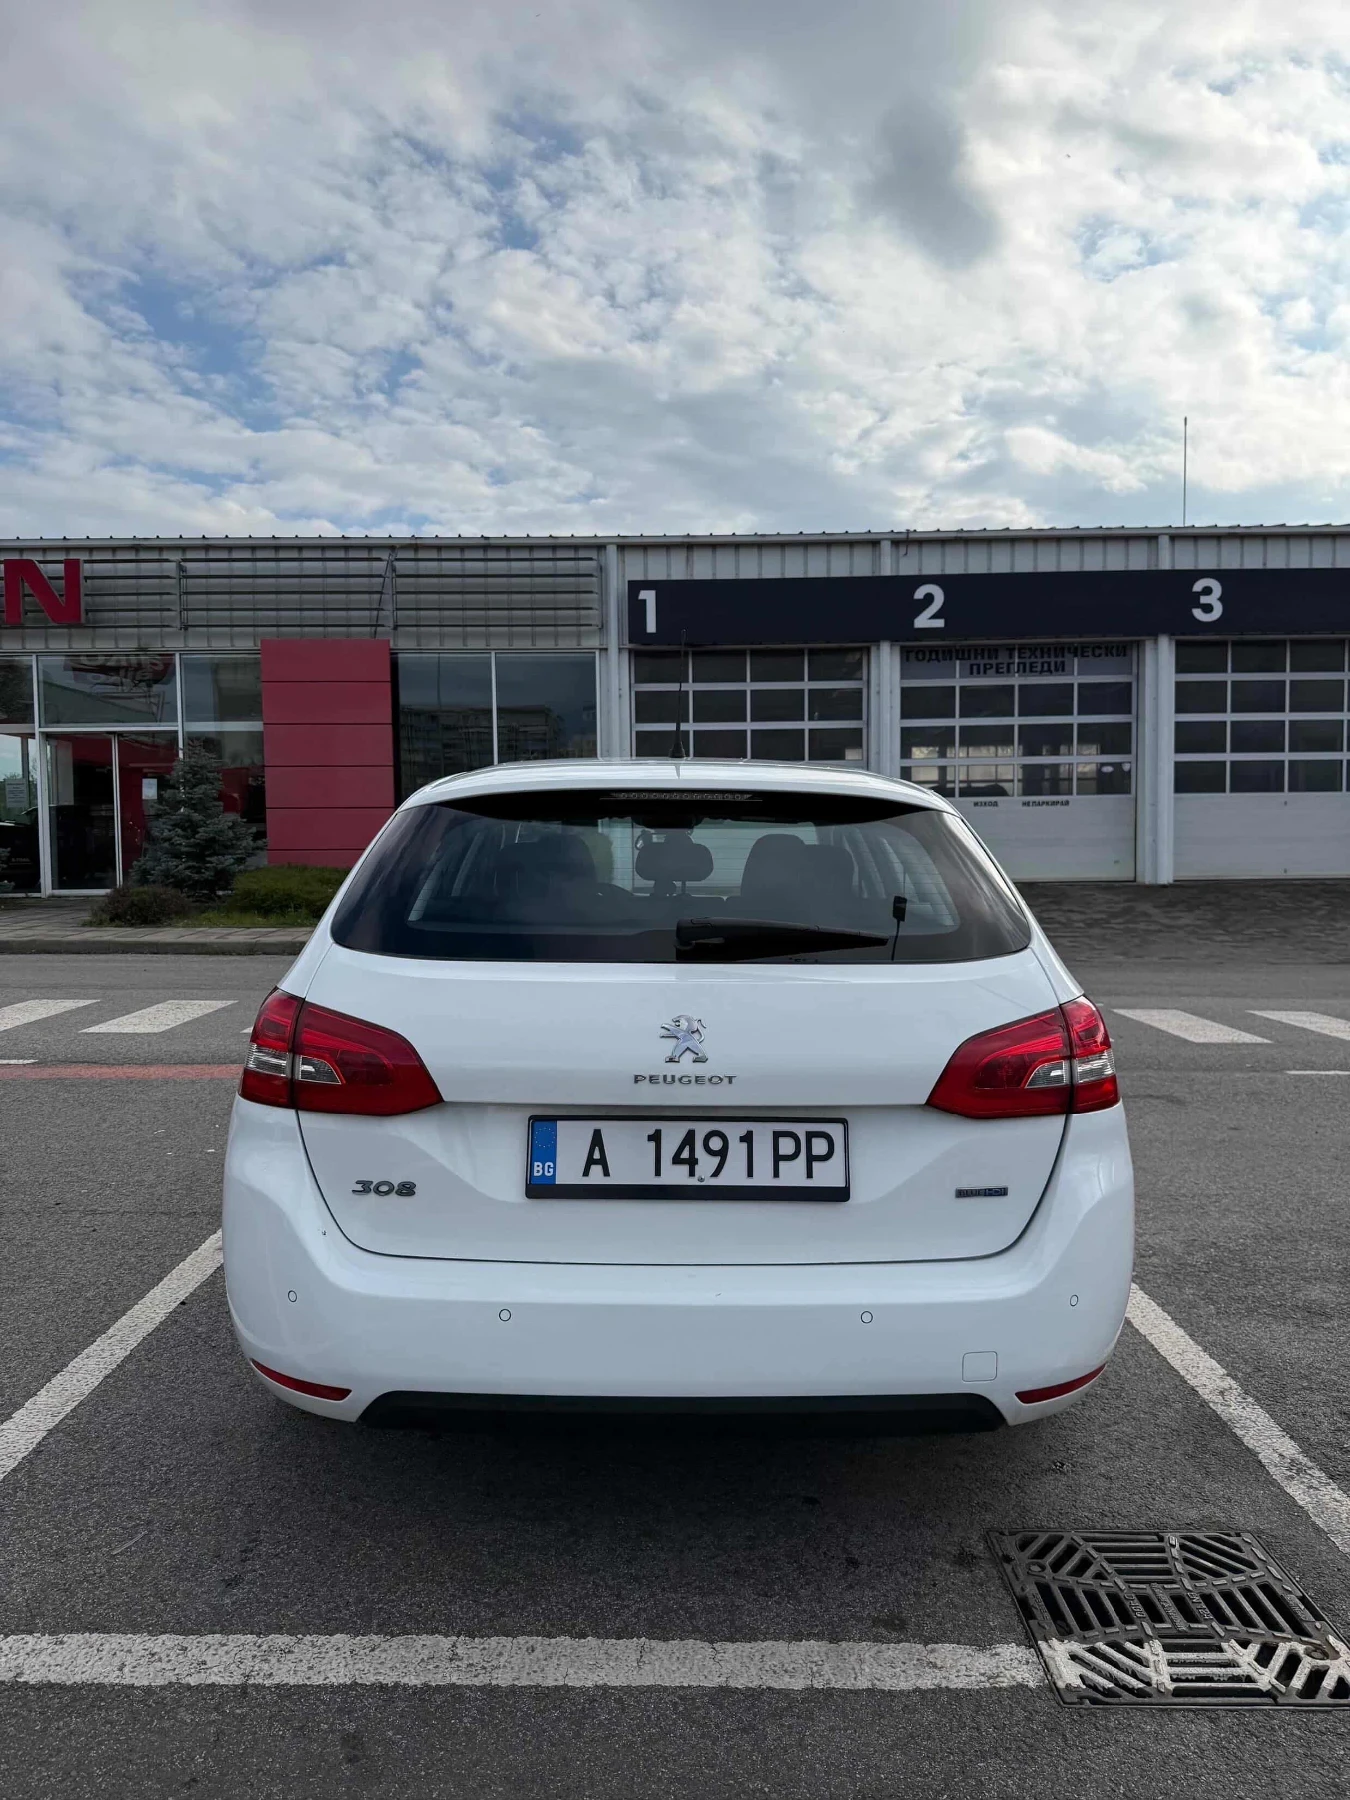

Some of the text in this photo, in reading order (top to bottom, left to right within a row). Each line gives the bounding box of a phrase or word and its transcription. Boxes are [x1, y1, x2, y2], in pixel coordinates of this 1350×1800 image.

[913, 584, 945, 628] 2
[1192, 578, 1223, 622] 3
[637, 590, 656, 633] 1
[905, 644, 1128, 663] ГОДИШНИ ТЕХНИЧЕСКИ
[969, 660, 1066, 676] ПРЕГЛЕДИ
[633, 1074, 737, 1085] PEUGEOT
[533, 1162, 554, 1176] BG
[351, 1180, 417, 1196] 308
